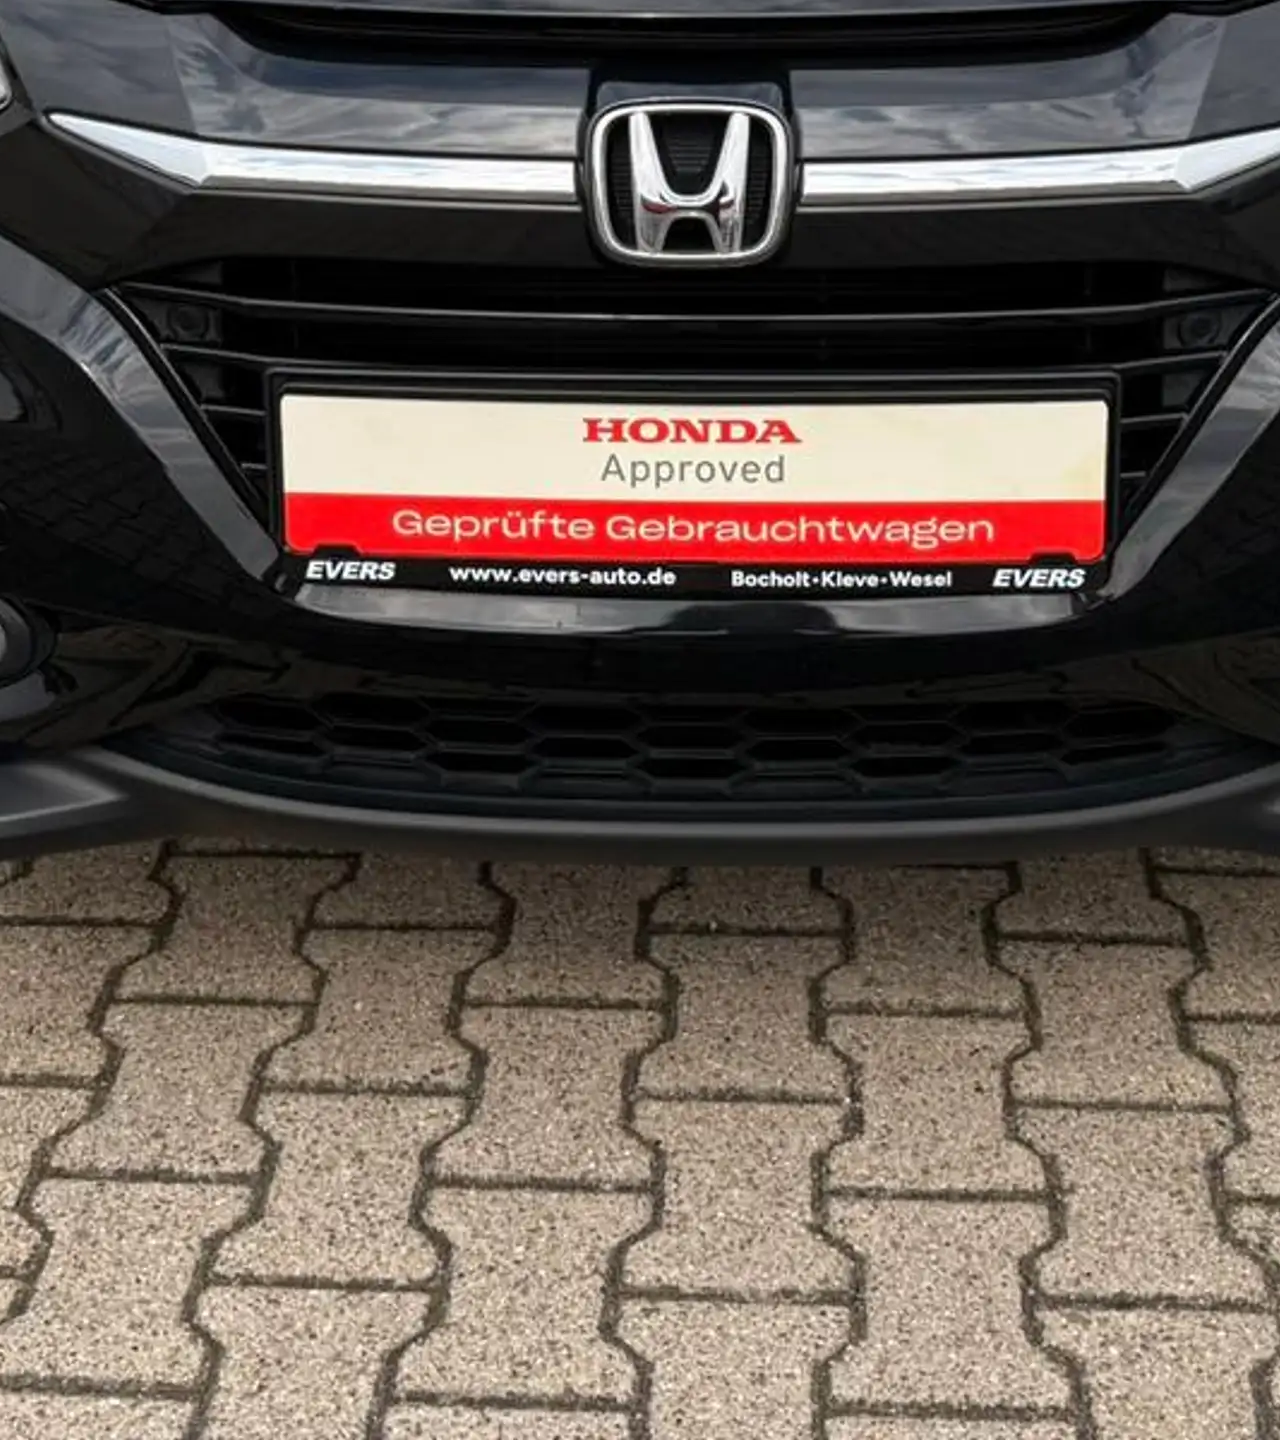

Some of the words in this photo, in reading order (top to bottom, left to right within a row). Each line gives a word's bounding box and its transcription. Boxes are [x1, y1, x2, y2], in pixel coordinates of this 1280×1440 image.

[582, 418, 802, 444] HONDA
[601, 453, 785, 488] Approved
[392, 509, 595, 541] Geprüfte
[606, 514, 995, 549] Gebrauchtwagen
[305, 561, 396, 580] EVERS
[449, 566, 677, 586] www.evers-auto.de
[992, 568, 1087, 588] EVERS
